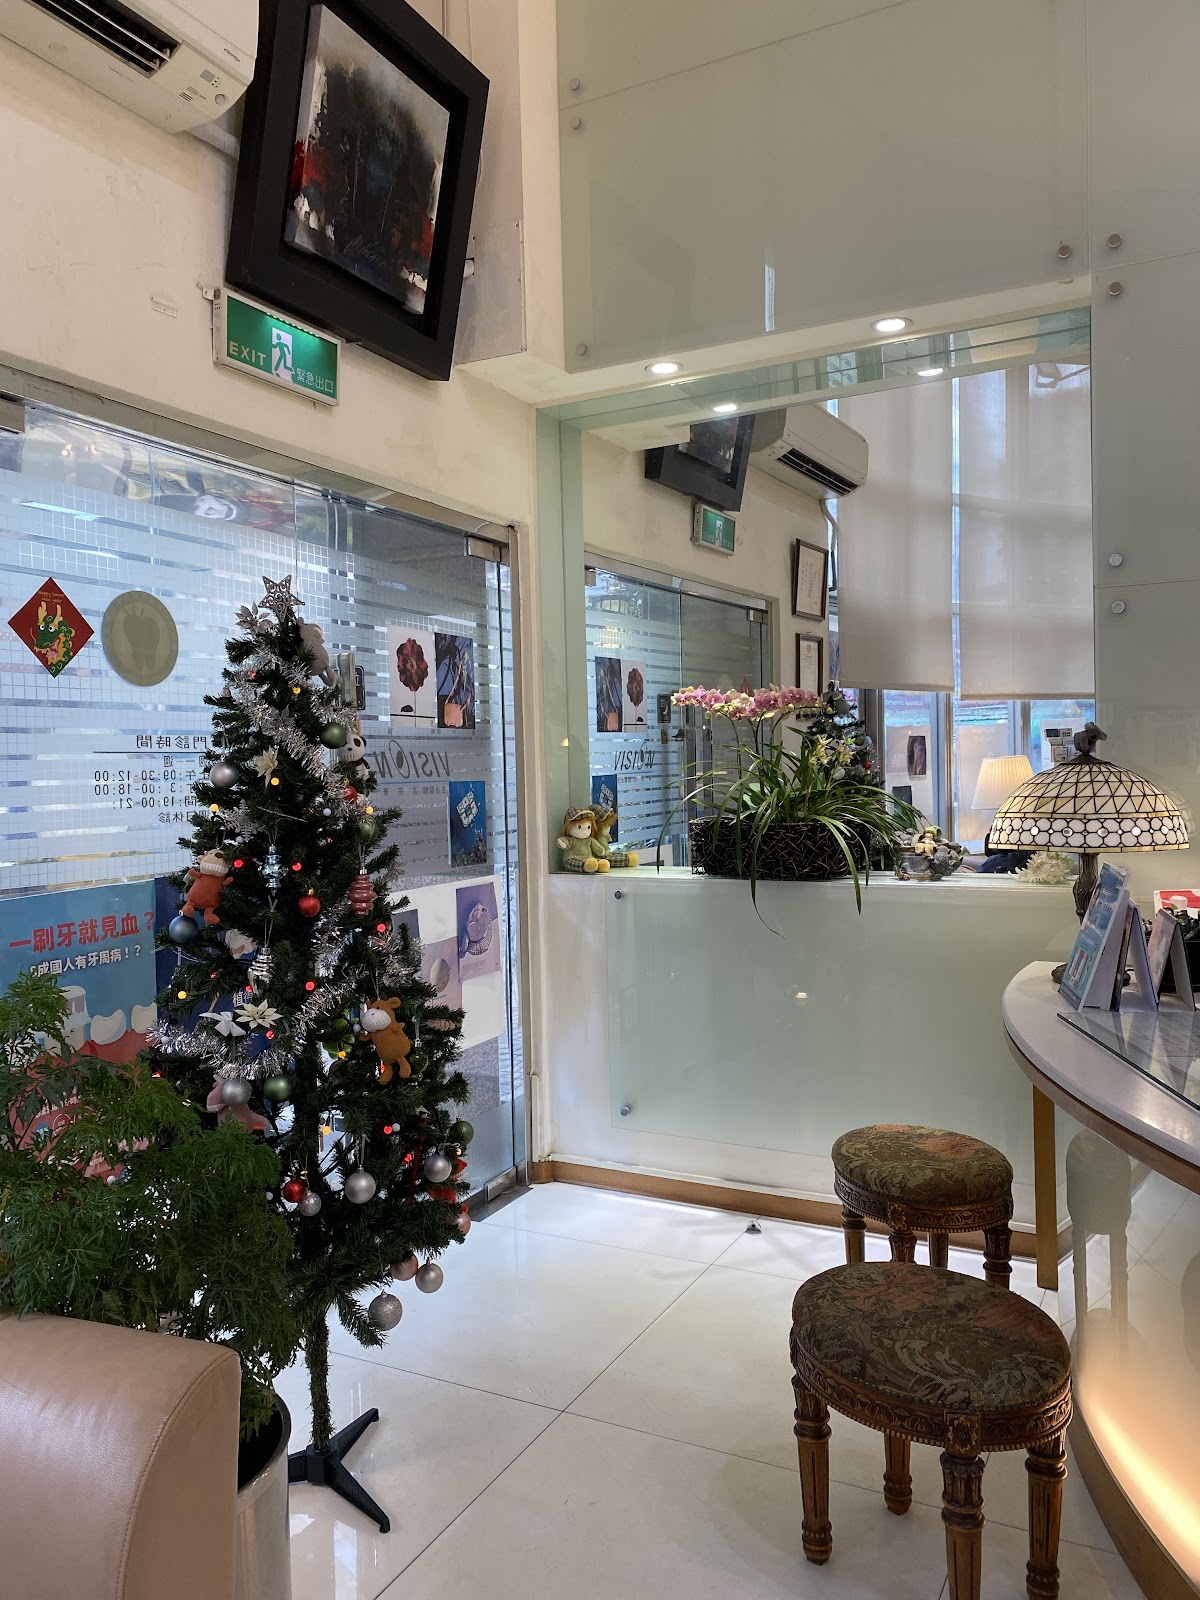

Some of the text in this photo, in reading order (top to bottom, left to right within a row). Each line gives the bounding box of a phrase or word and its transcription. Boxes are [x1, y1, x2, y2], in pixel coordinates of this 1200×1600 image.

[229, 340, 267, 366] EXIT
[296, 367, 334, 393] 緊急出口
[614, 741, 656, 771] VISION
[9, 911, 155, 954] 一刷牙就見血？
